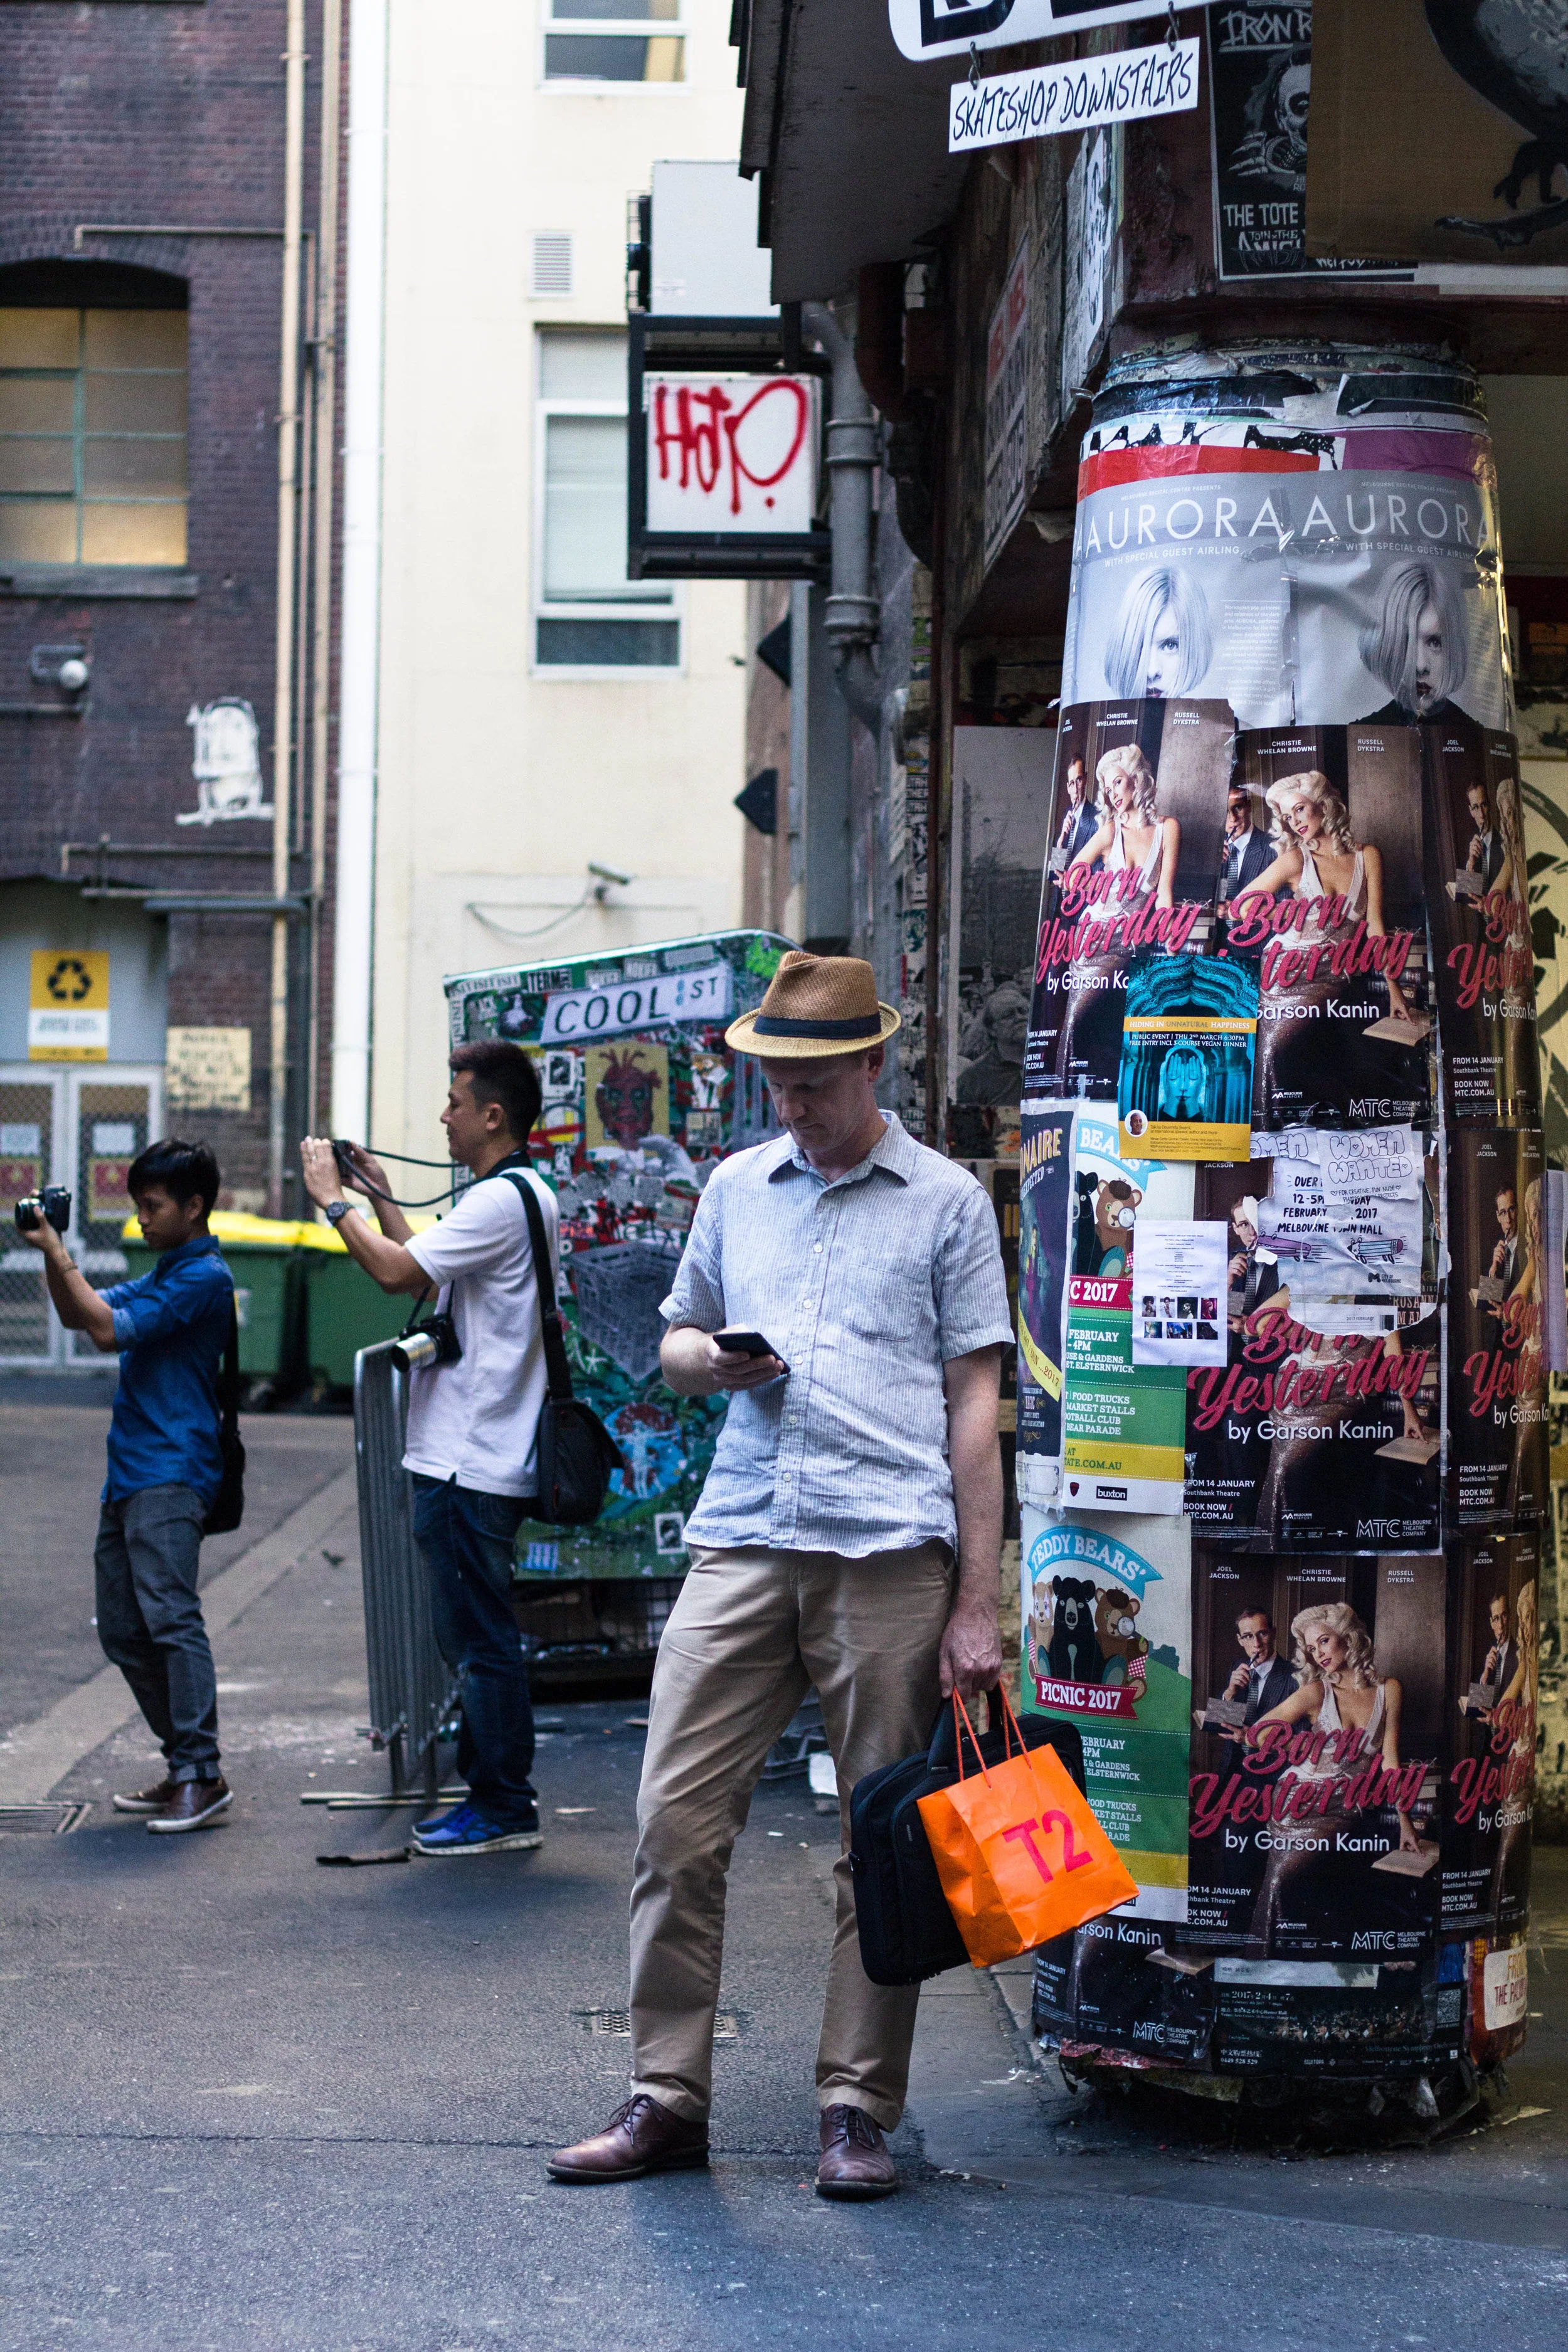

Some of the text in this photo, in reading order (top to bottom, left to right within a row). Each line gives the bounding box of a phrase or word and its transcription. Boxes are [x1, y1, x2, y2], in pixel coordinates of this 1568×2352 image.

[1219, 11, 1291, 46] IRON
[953, 51, 1193, 140] SKATESHOP DOWNSTAIRS
[1223, 203, 1298, 227] THE TOTE
[1192, 484, 1221, 492] PRESENTS
[1086, 495, 1283, 554] AURORA
[1104, 546, 1239, 567] WITH SPECIAL GUEST AIRLING
[1346, 542, 1474, 562] WITH SPECIAL GUEST AIRLING
[1061, 861, 1145, 917] Born
[1227, 889, 1351, 947] Born
[1037, 892, 1202, 985] Yesterday
[1047, 974, 1059, 994] by
[1061, 971, 1109, 990] Garson
[554, 986, 670, 1034] COOL
[1327, 999, 1379, 1019] Kanin
[1483, 1000, 1496, 1022] by
[1480, 1056, 1503, 1064] JANUARY
[1455, 1088, 1494, 1096] MTC.COM.AU
[1349, 1099, 1391, 1118] MTC
[1330, 1130, 1405, 1160] WOMEN
[1328, 1156, 1412, 1184] WANTED
[1295, 1176, 1318, 1187] OVER
[1283, 1207, 1327, 1218] FEBRUARY
[1277, 1222, 1383, 1236] MELBOURNE HALL
[1083, 1281, 1119, 1303] 2017
[1069, 1329, 1119, 1343] FEBRUARY
[1075, 1362, 1135, 1374] ELSTERNWICK
[1085, 1353, 1123, 1364] GARDENS
[1188, 1341, 1428, 1431] Yesterday
[1073, 1392, 1130, 1404] FOOD TRUCKS
[1099, 1403, 1135, 1415] STALLS
[1495, 1404, 1540, 1428] by Garson
[1066, 1422, 1121, 1435] BEAR PARADE
[1098, 1415, 1121, 1425] CLUB
[1229, 1419, 1393, 1444] by Garson Kanin
[1097, 1486, 1126, 1500] buxton
[1356, 1519, 1401, 1539] MTC
[1032, 1534, 1071, 1569] TEDDY
[1041, 1682, 1121, 1710] PICNIC 2017
[1242, 1719, 1368, 1775] Born
[1086, 1769, 1140, 1781] ELSTERNWICK
[1095, 1761, 1130, 1771] GARDENS
[1106, 1801, 1136, 1811] TRUCKS
[1189, 1754, 1429, 1838] Yesterday
[1109, 1822, 1130, 1831] CLUB
[1111, 1812, 1142, 1822] STALLS
[1478, 1809, 1527, 1833] by Garson
[1002, 1809, 1093, 1885] T2
[1226, 1830, 1390, 1853] by Garson Kanin
[1470, 1868, 1491, 1878] JANUARY
[1200, 1887, 1251, 1896] 14 JANUARY
[1460, 1894, 1474, 1902] NOW
[1442, 1902, 1477, 1912] MTC.COM.AU
[1118, 1922, 1161, 1946] Kanin
[1351, 1931, 1395, 1950] MTC
[1133, 2021, 1165, 2043] MTC
